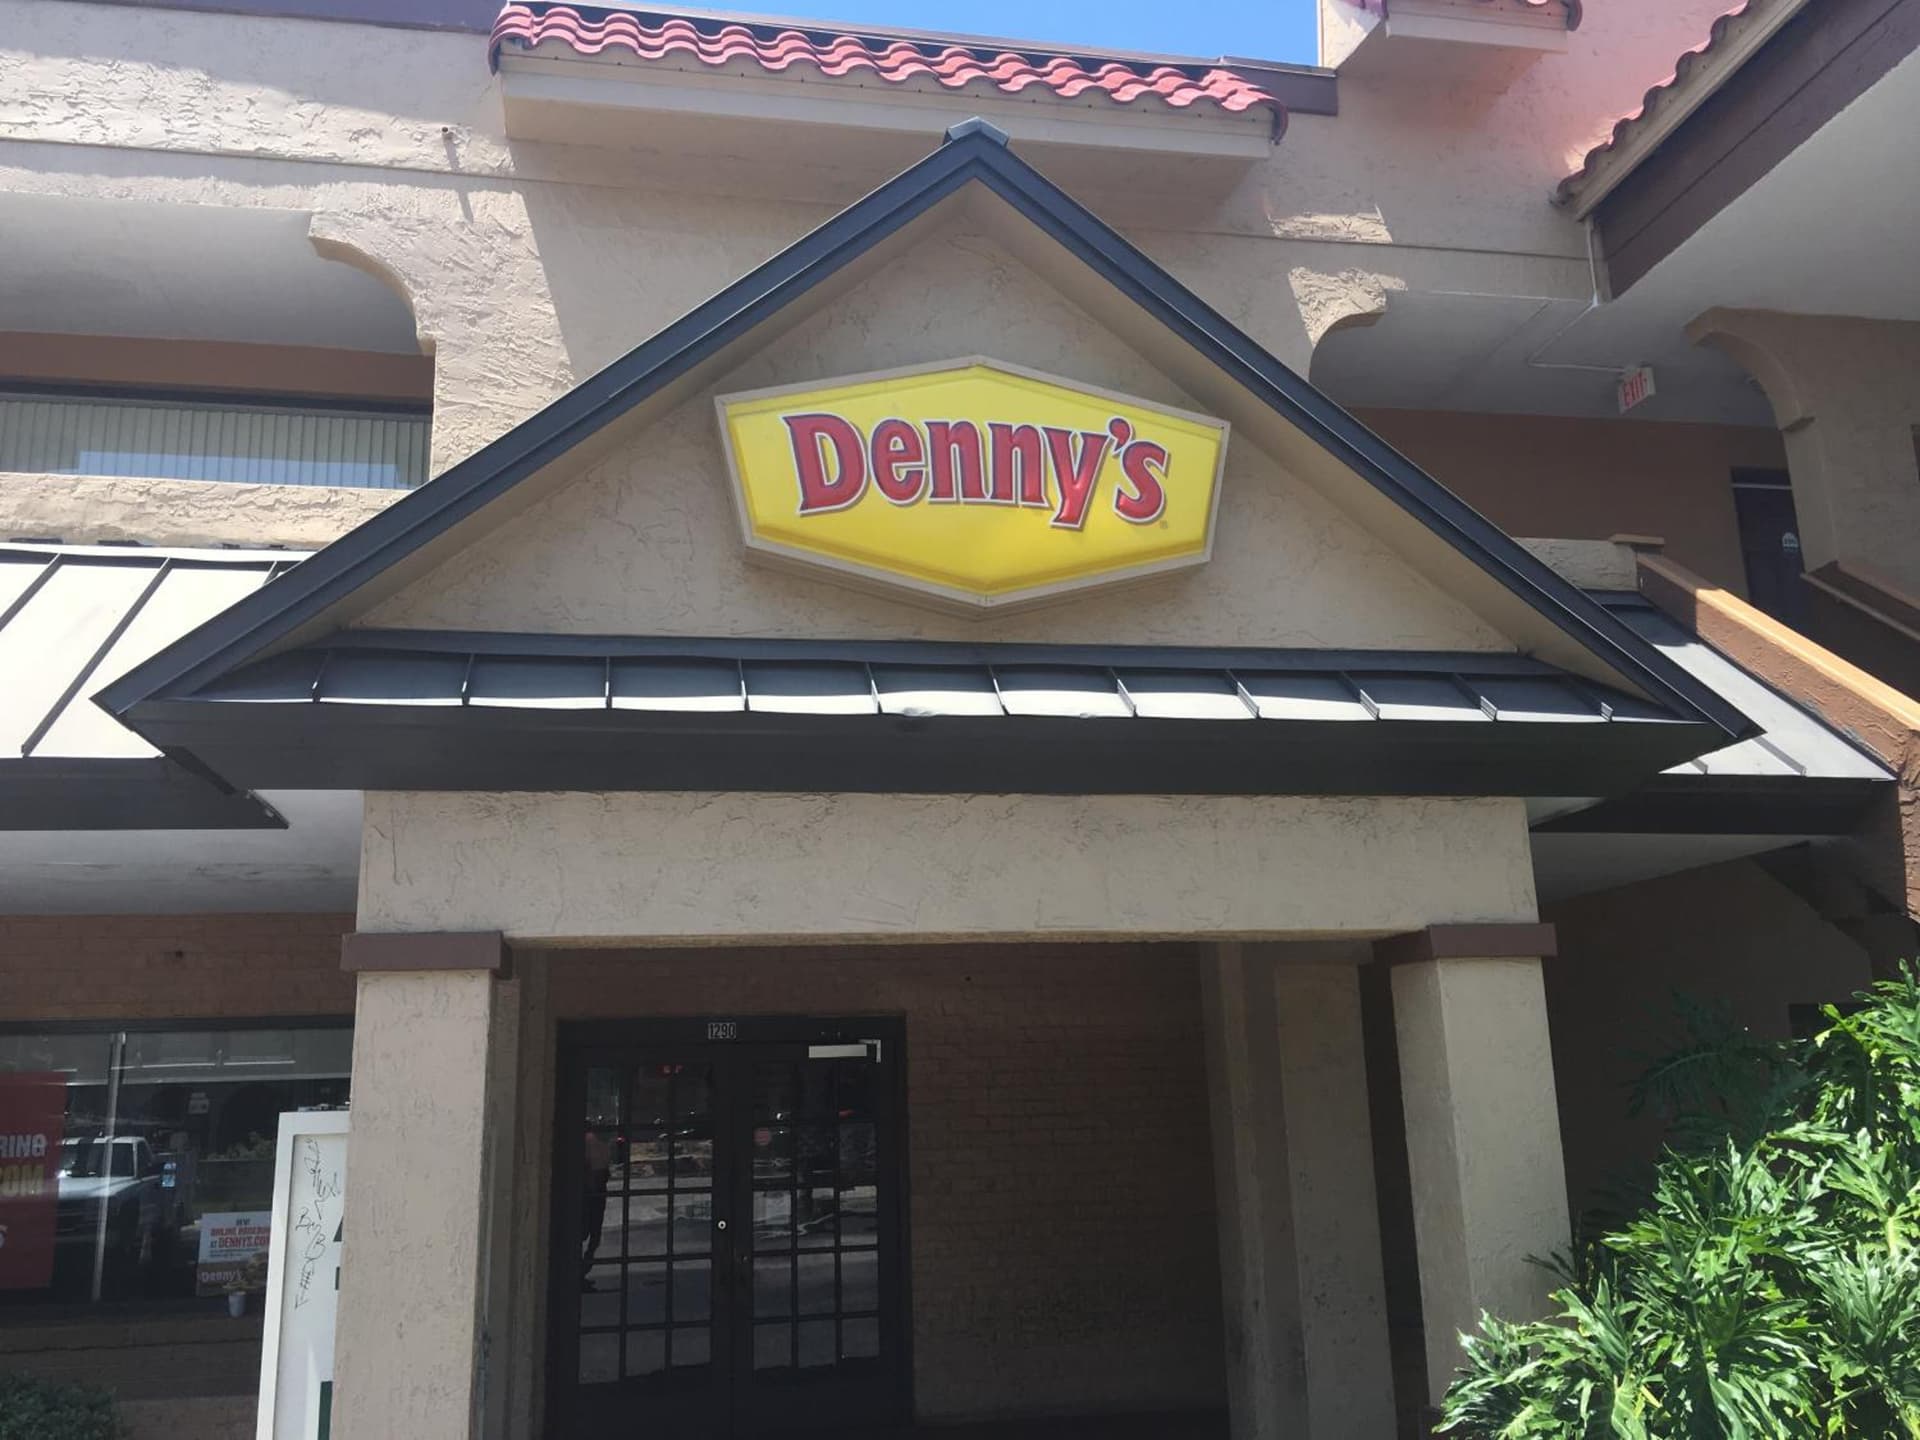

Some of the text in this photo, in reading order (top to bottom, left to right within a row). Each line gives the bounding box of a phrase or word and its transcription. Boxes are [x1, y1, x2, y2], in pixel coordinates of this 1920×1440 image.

[780, 411, 1169, 529] Denny's
[708, 1022, 737, 1040] 1290
[0, 1165, 44, 1198] OM
